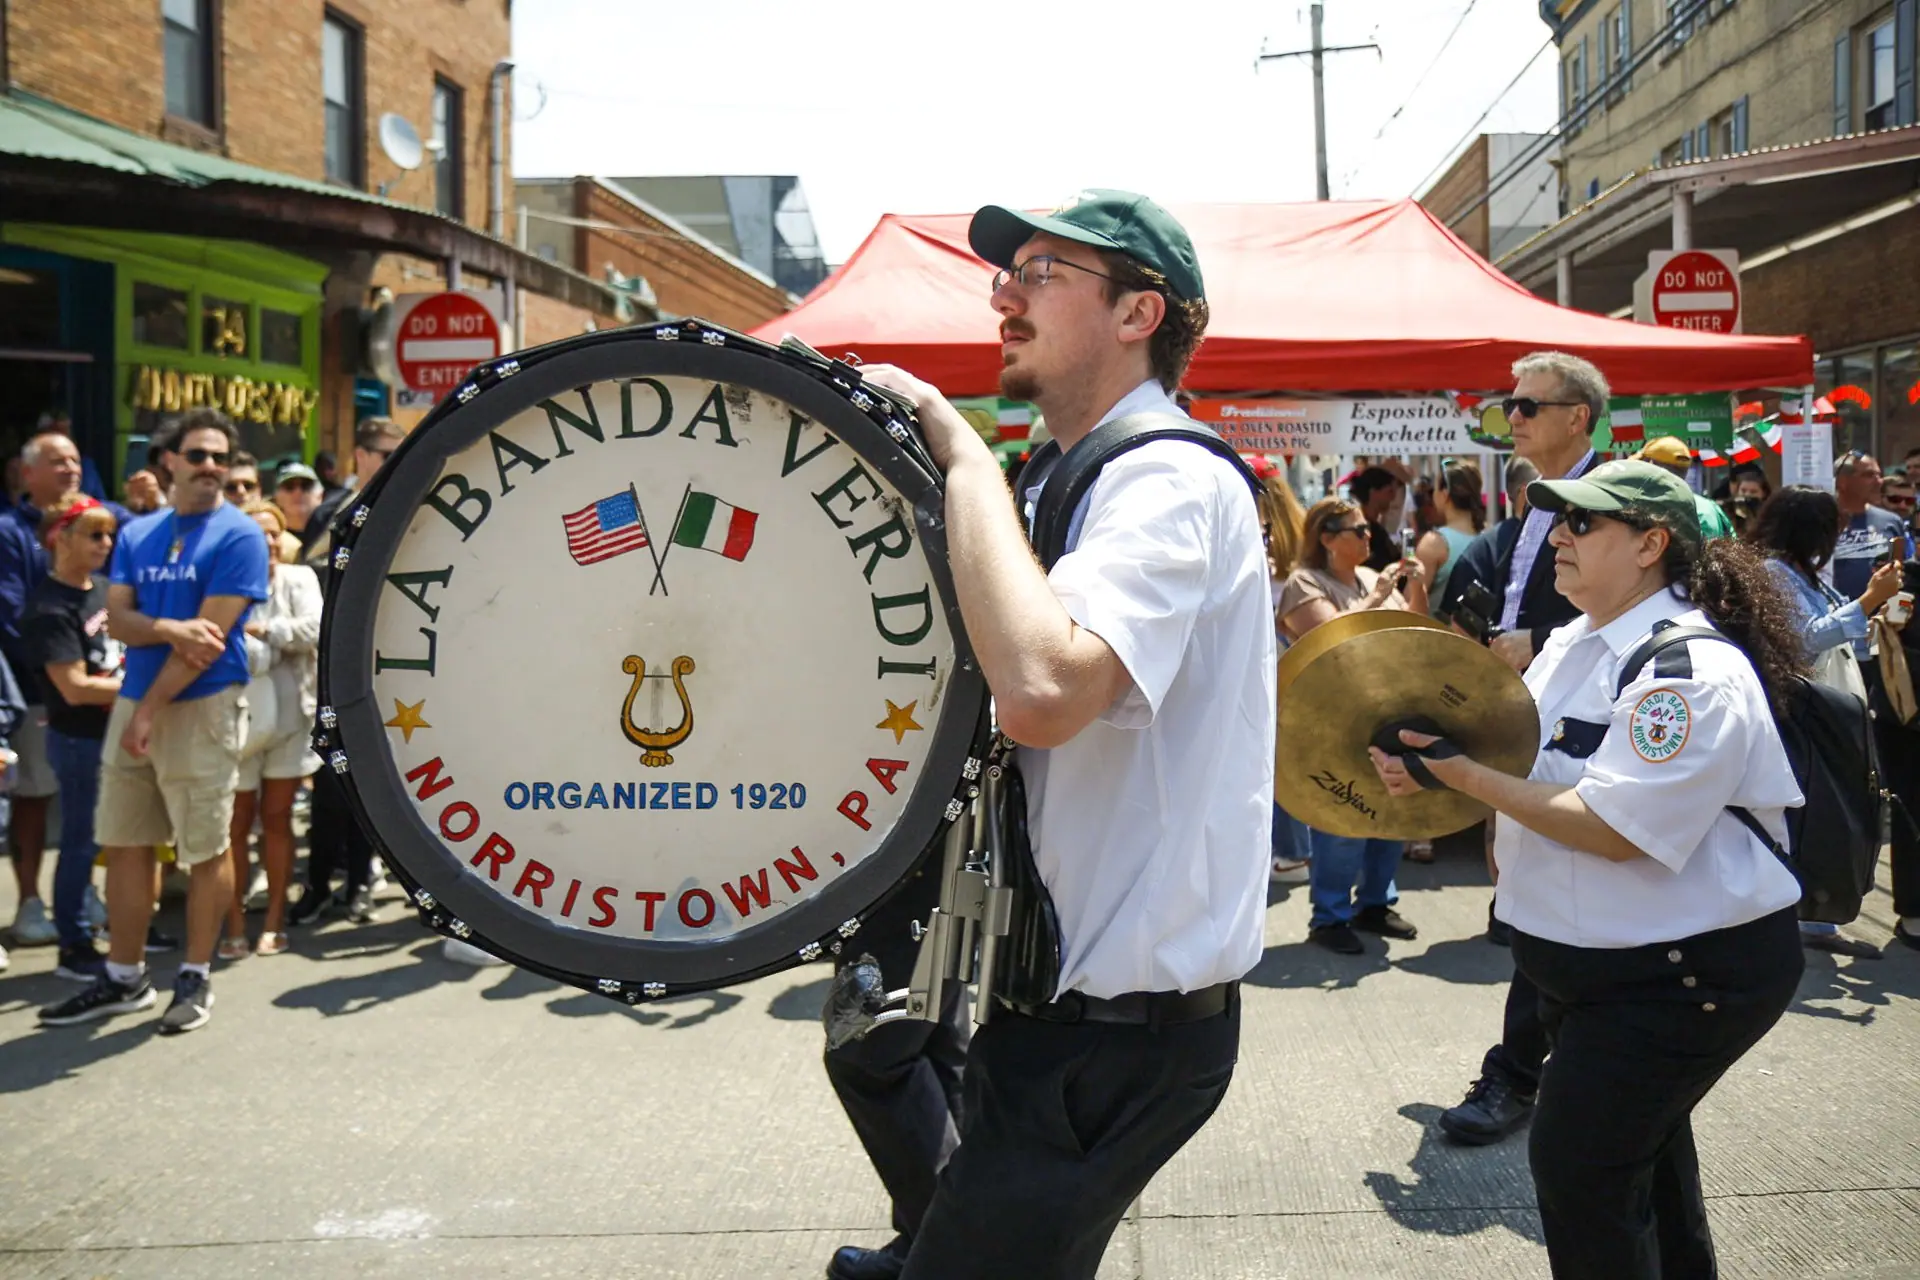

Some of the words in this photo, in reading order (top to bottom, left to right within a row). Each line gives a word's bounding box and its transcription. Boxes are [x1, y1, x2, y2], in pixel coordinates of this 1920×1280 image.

[1664, 271, 1686, 288] DO
[1695, 271, 1725, 287] NOT
[411, 314, 437, 335] DO
[447, 314, 485, 334] NOT
[1673, 315, 1721, 331] ENTER
[418, 365, 473, 386] ENTE
[1350, 401, 1462, 425] Esposito's
[1241, 422, 1272, 434] OVEN
[1277, 422, 1332, 434] ROASTED
[1350, 424, 1457, 442] Porchetta
[1291, 437, 1312, 450] PIG
[375, 565, 453, 677] LA
[425, 377, 740, 542] BANDA
[780, 409, 937, 680] VERDI
[137, 564, 197, 583] ITALIA
[1637, 693, 1664, 716] VERDI
[1667, 695, 1687, 722] BAND
[1633, 725, 1683, 758] NORRISTOWN
[504, 781, 718, 810] ORGANIZED
[731, 781, 807, 810] 1920
[1308, 769, 1377, 820] Zildjian
[404, 756, 846, 931] NORRISTOWN,
[836, 756, 909, 832] PA
